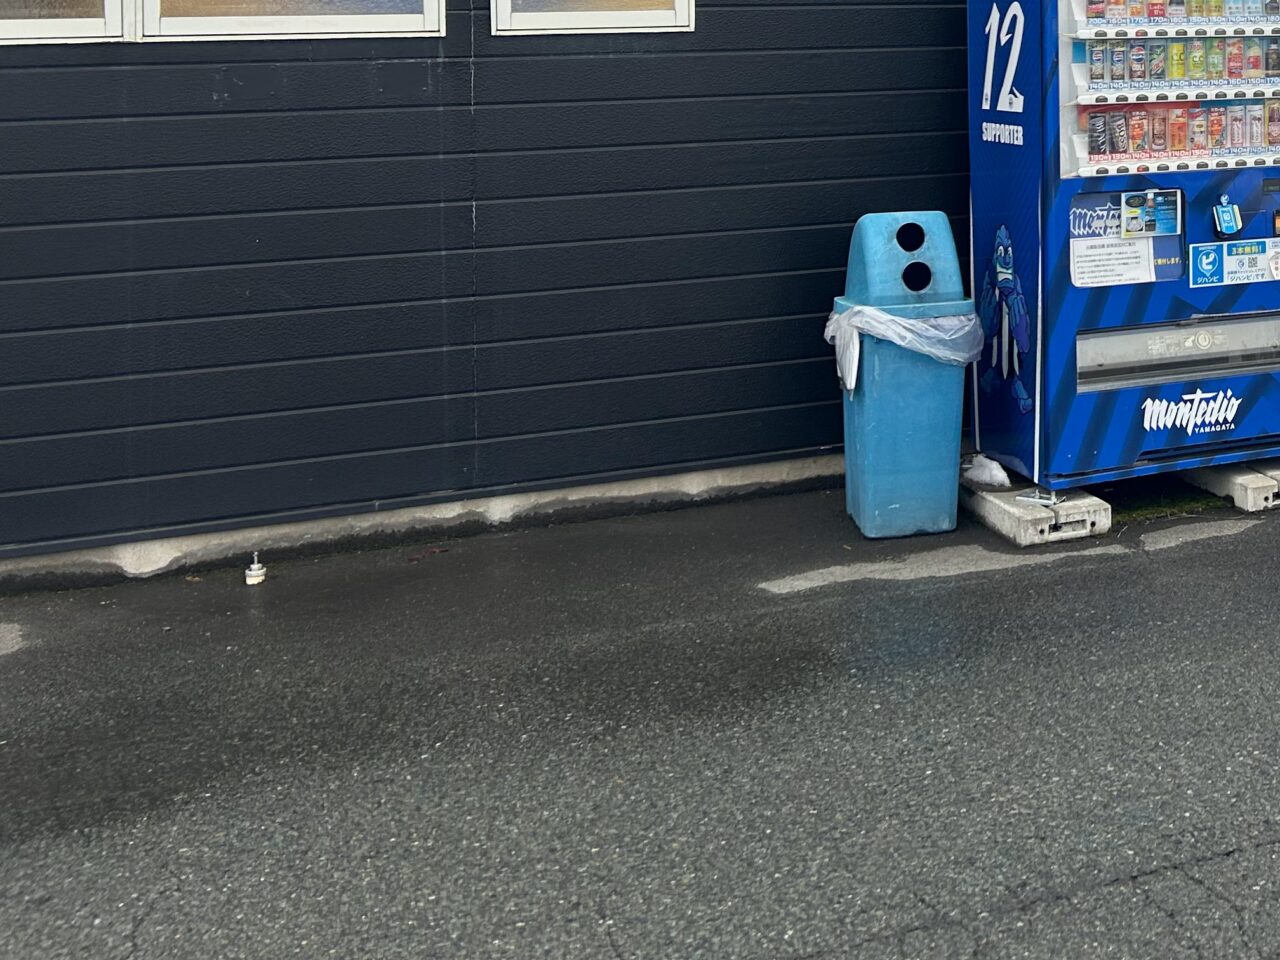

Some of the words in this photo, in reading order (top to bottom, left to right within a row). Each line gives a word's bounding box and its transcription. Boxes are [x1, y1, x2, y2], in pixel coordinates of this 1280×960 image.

[981, 1, 1025, 113] 12
[982, 122, 1024, 146] SUPPORTER
[1194, 422, 1236, 434] YAMAGATA
